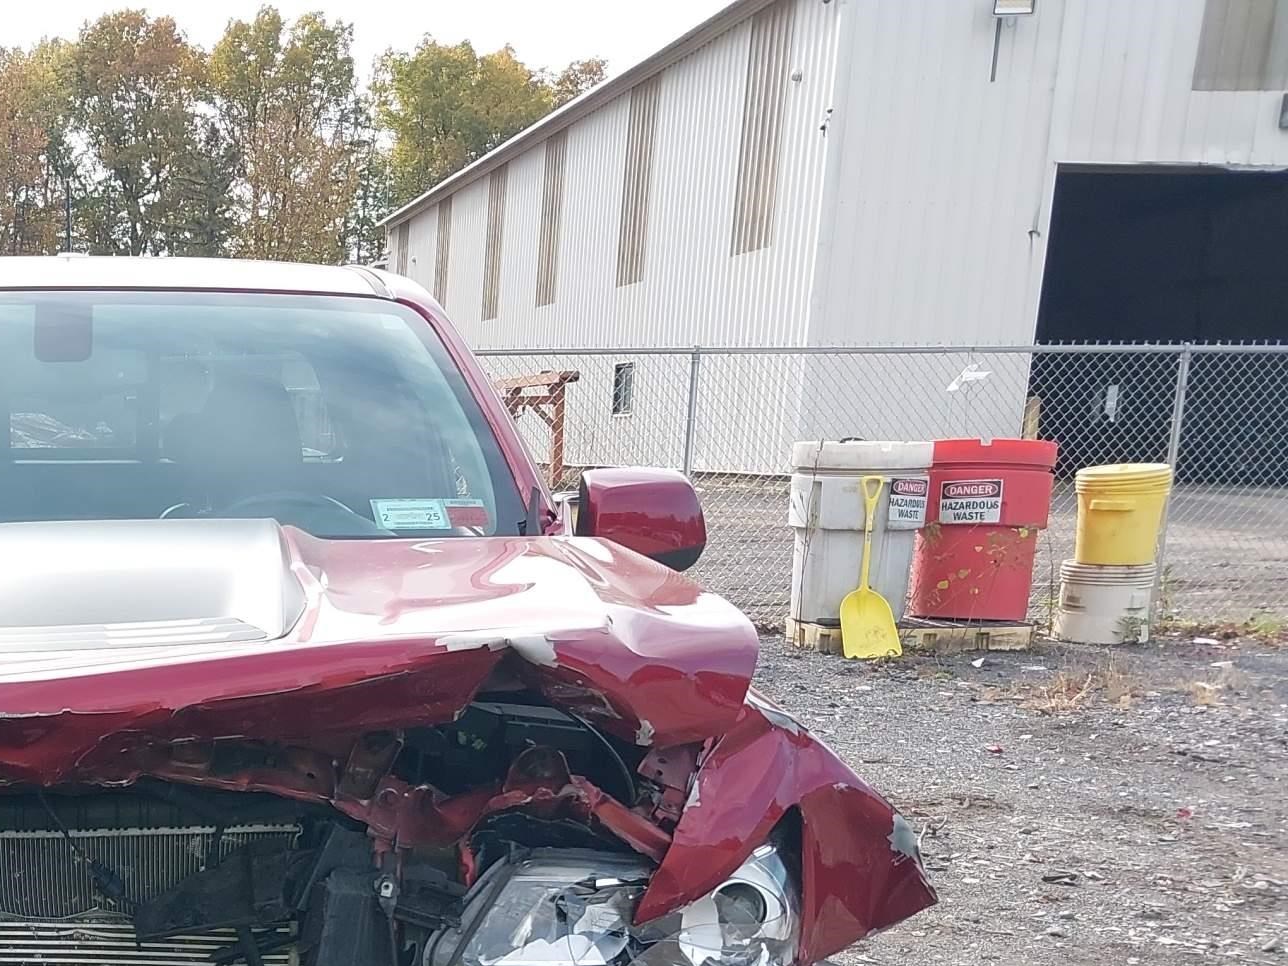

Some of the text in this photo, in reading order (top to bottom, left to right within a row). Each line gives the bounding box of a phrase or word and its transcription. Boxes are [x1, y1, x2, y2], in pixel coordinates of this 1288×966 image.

[949, 485, 993, 495] DANGER
[941, 500, 999, 511] HAZARDOUS
[425, 512, 441, 521] 25
[898, 508, 920, 520] WASTE
[952, 511, 986, 521] WASTE
